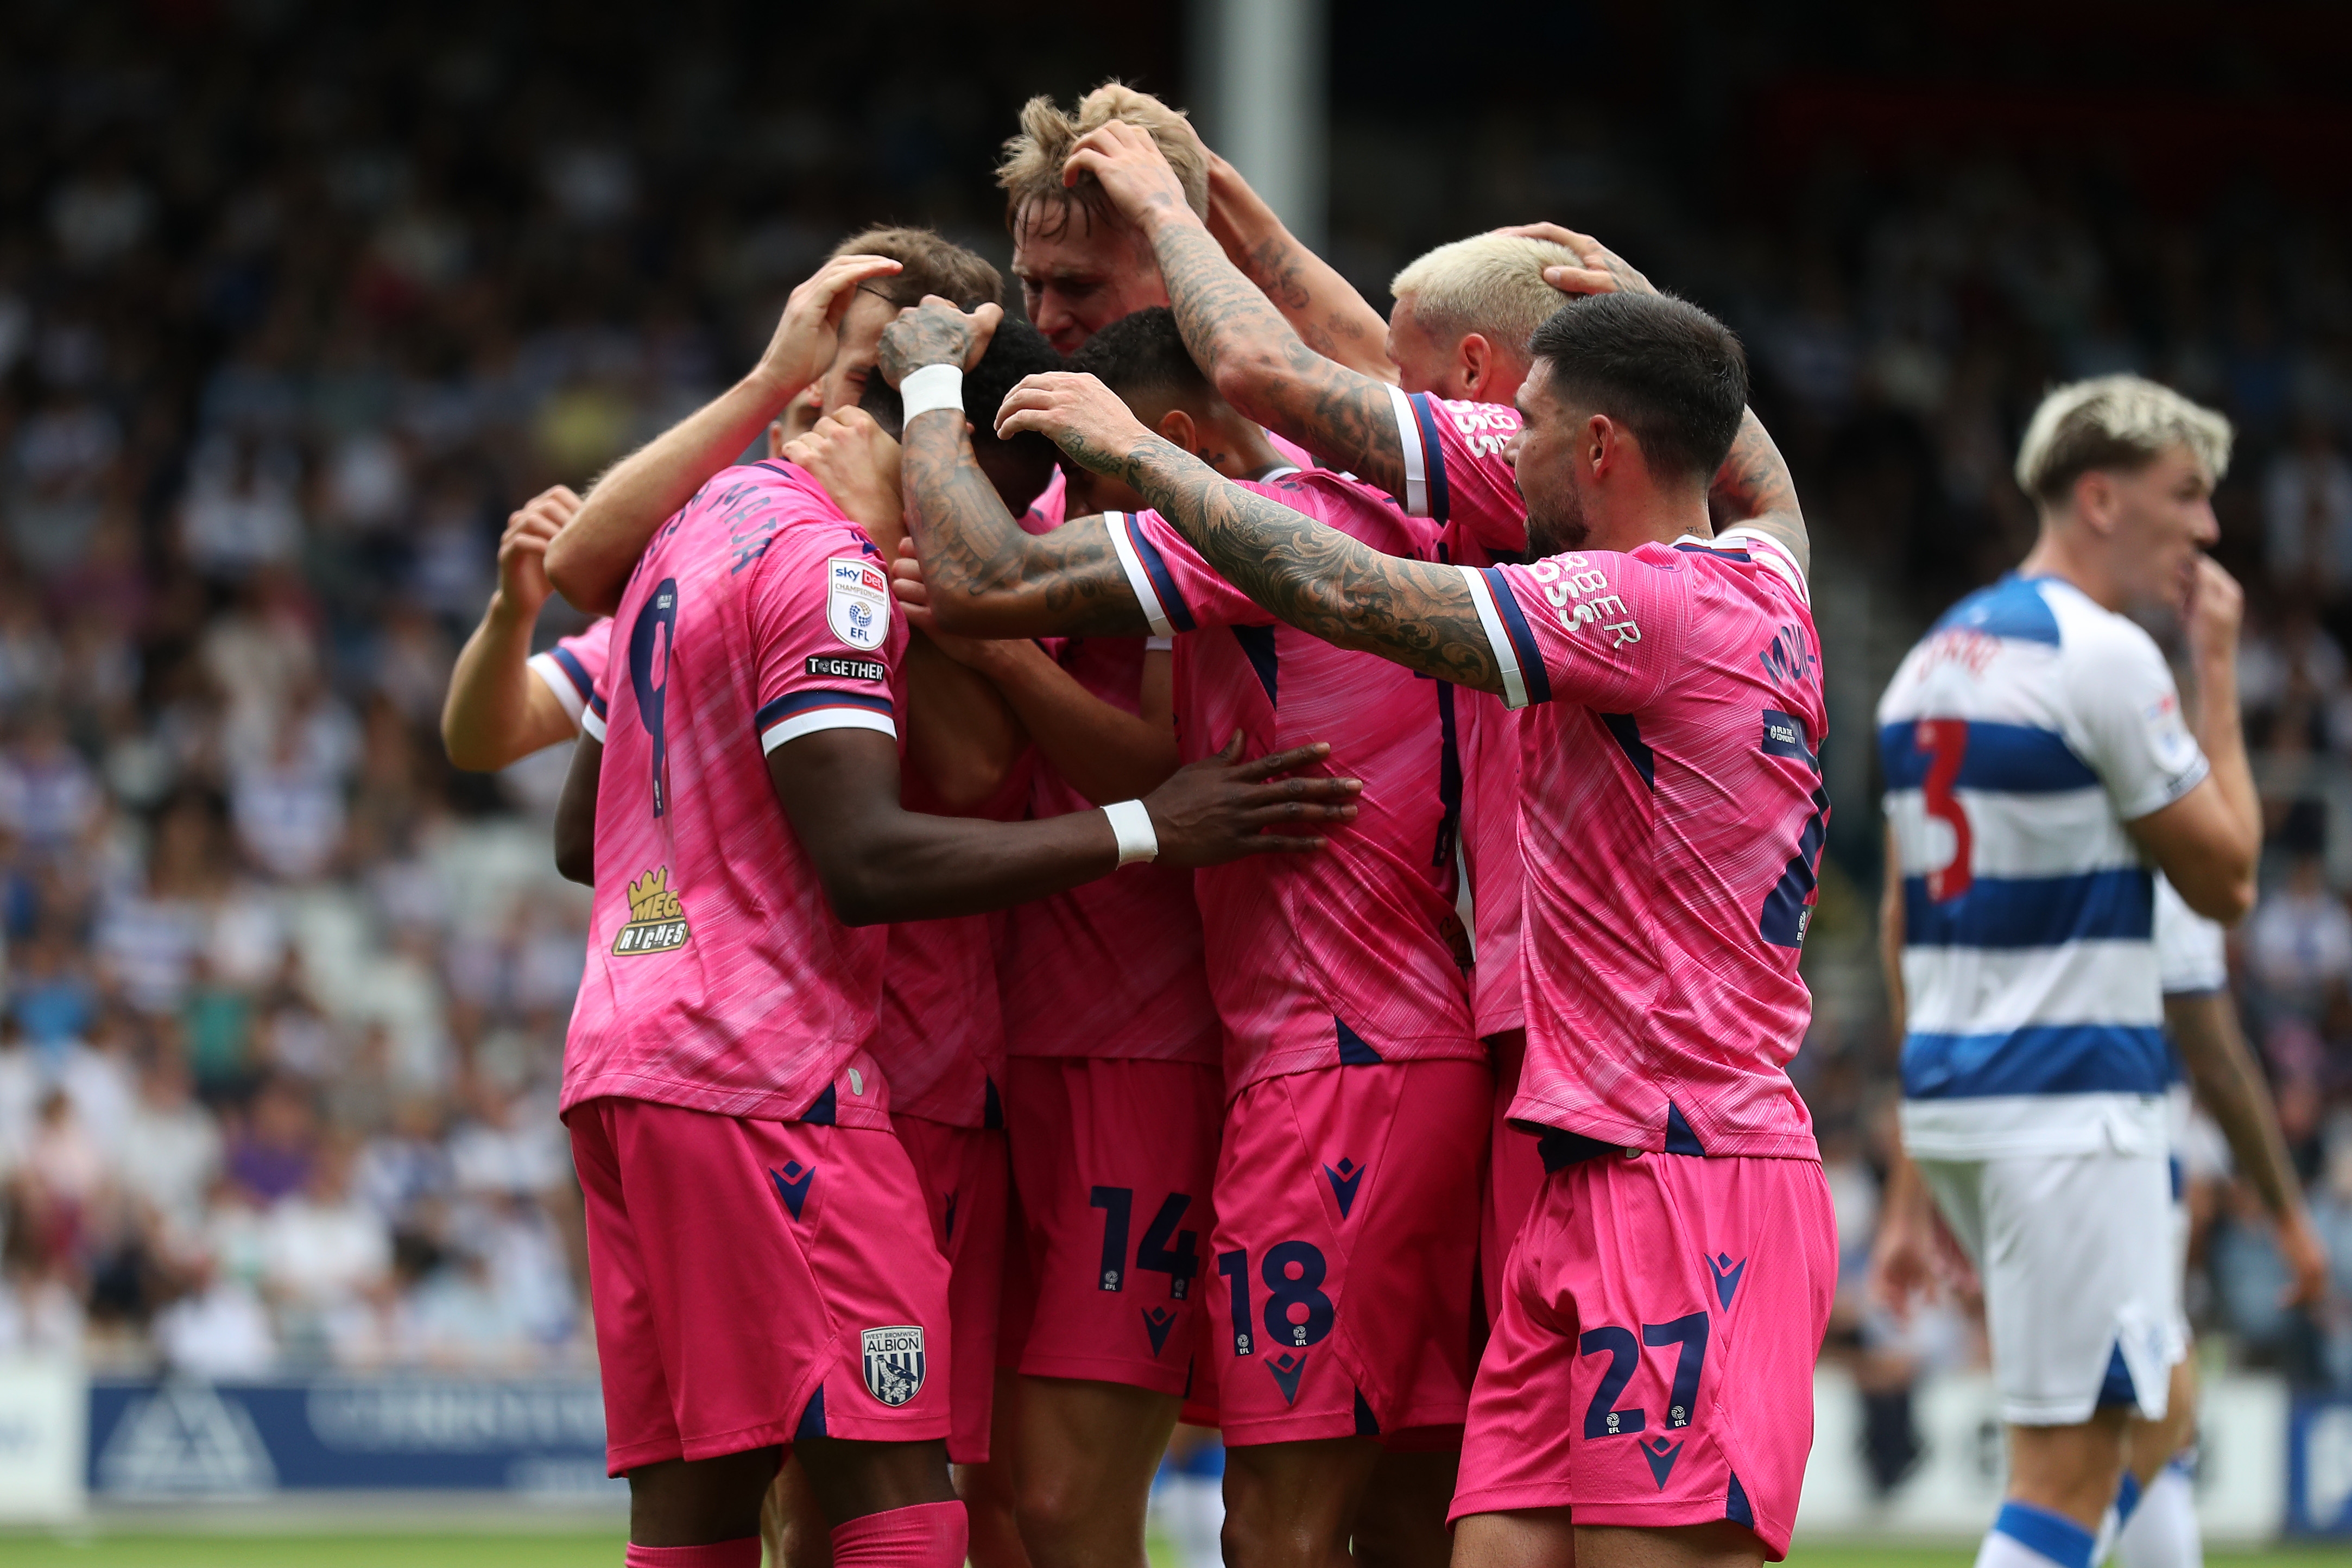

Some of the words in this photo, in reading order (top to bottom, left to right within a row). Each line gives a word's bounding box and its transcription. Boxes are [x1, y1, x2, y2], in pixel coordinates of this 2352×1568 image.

[707, 482, 776, 576] MAJA
[836, 567, 860, 582] sky
[864, 571, 883, 590] bet
[836, 583, 885, 601] CHAMPIONSHIP
[851, 627, 869, 642] EFL
[629, 578, 678, 819] 9
[1915, 719, 1975, 905] 3
[619, 922, 686, 950] RICHES
[1090, 1185, 1199, 1300] 14
[867, 1337, 920, 1352] ALBION
[1218, 1240, 1334, 1357] 18
[1579, 1311, 1710, 1440] 27
